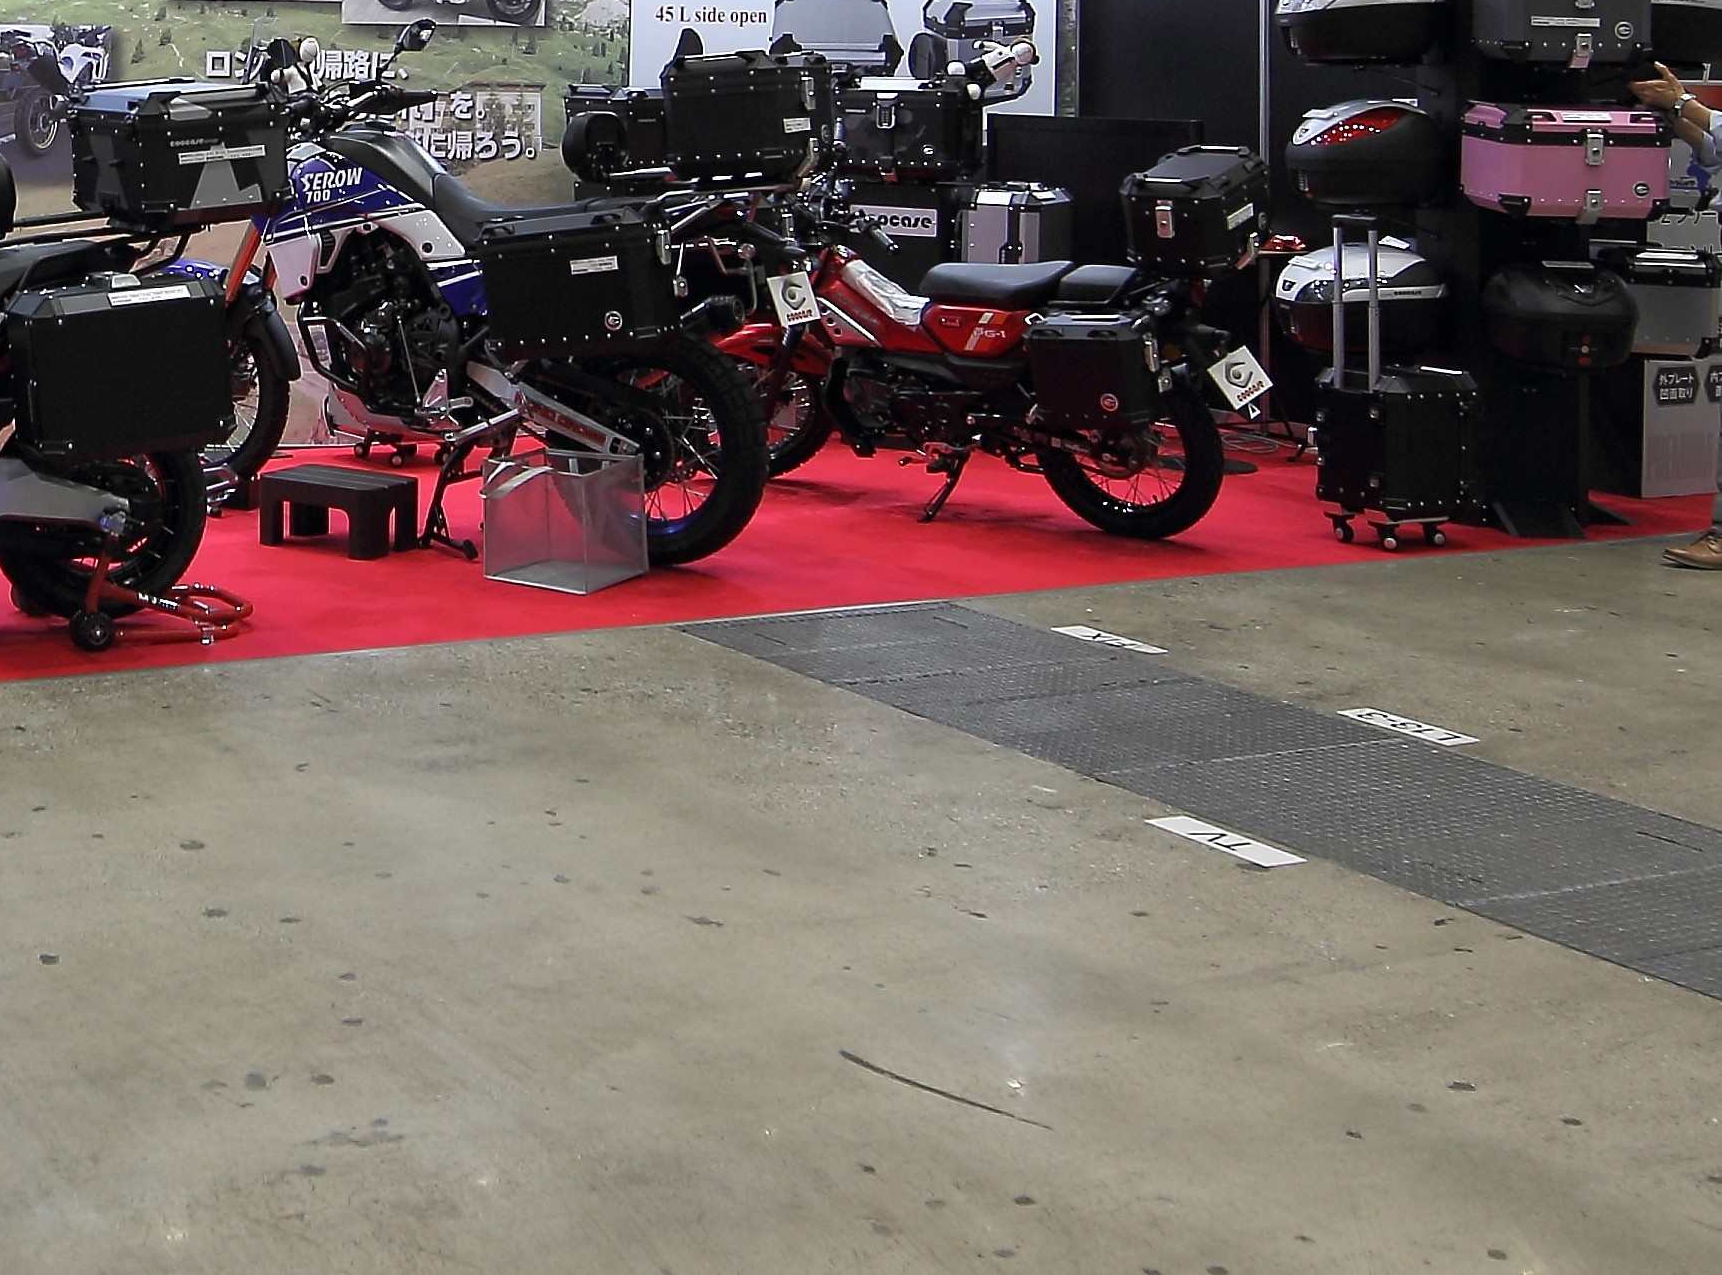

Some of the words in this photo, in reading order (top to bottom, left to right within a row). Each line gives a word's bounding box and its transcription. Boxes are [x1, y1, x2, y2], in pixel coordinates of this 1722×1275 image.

[655, 6, 675, 23] 45
[679, 6, 691, 23] L
[694, 6, 726, 24] side
[729, 11, 768, 28] open
[300, 167, 363, 192] SEROW
[305, 189, 331, 204] 700
